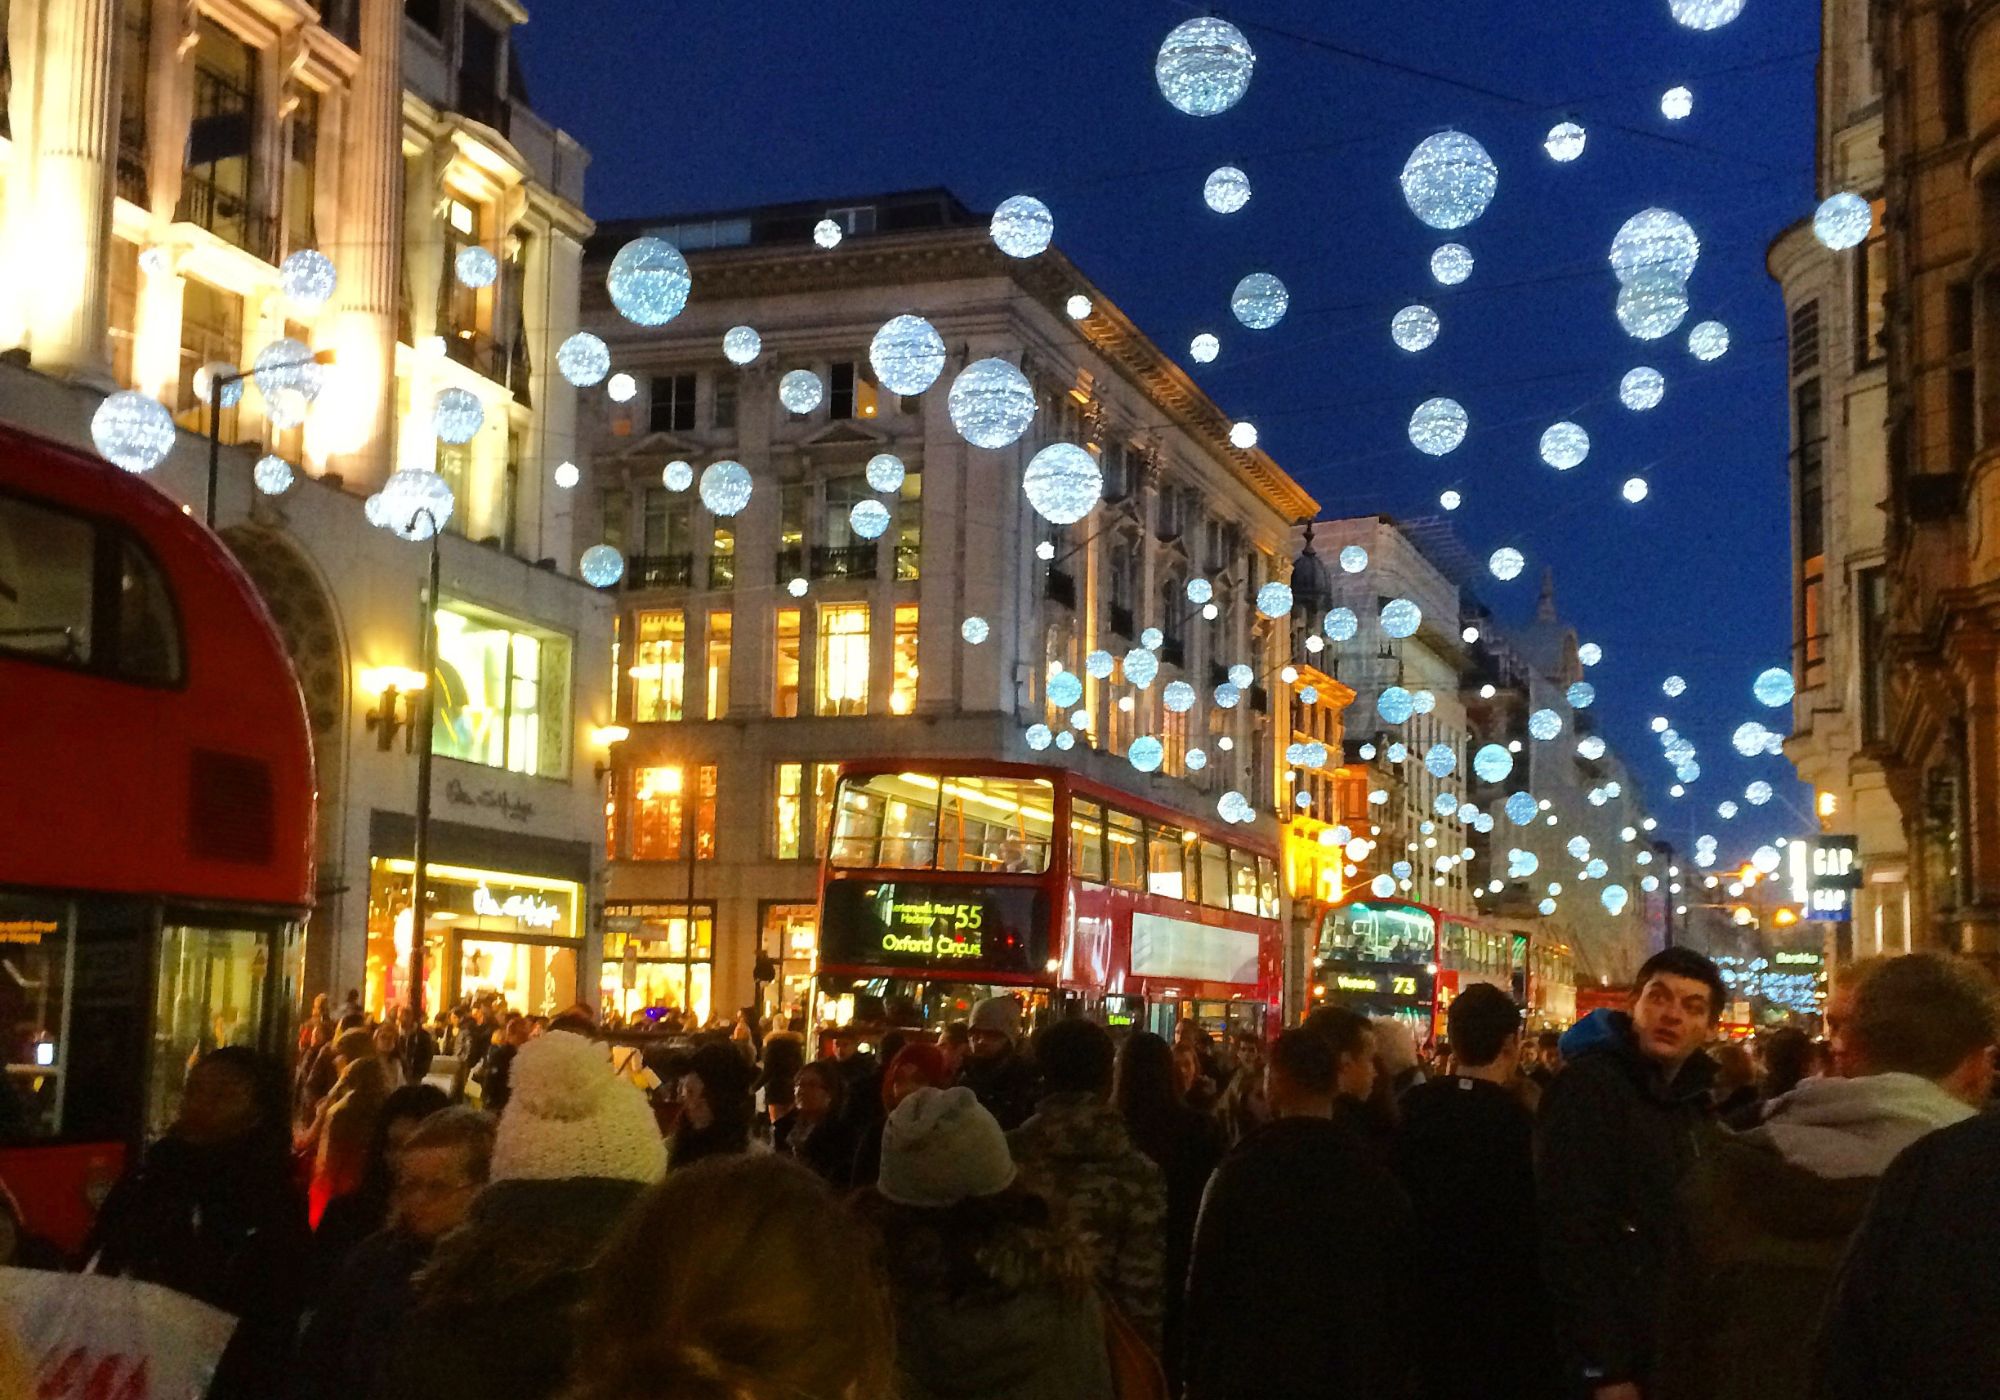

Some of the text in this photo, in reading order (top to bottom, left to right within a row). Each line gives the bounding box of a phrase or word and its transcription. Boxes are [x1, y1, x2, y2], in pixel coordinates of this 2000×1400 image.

[1814, 848, 1852, 875] GAP
[1814, 890, 1845, 911] GAP
[955, 905, 982, 929] 55
[882, 934, 981, 955] Oxford Circus
[1393, 977, 1416, 995] 73
